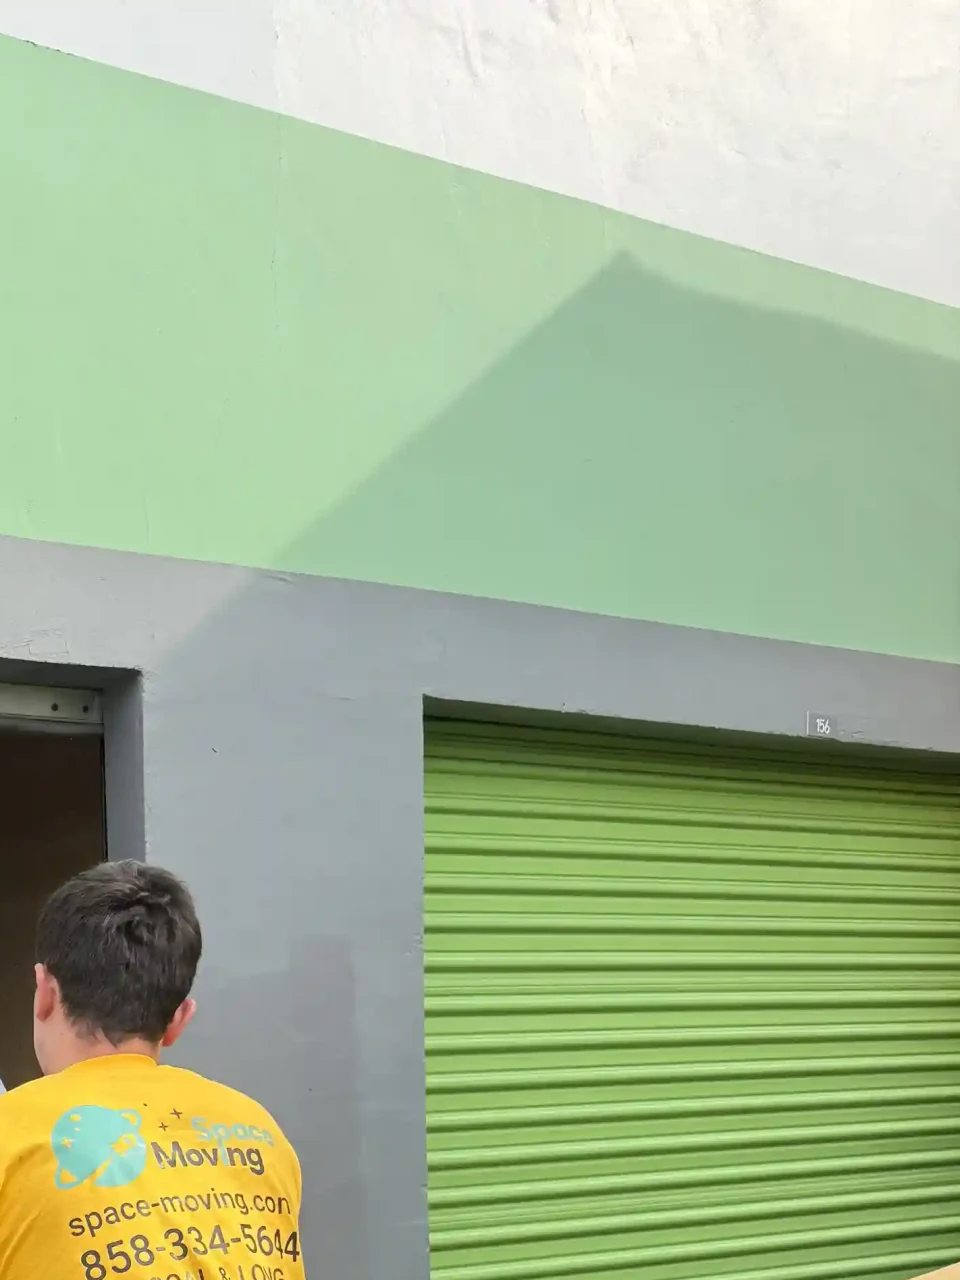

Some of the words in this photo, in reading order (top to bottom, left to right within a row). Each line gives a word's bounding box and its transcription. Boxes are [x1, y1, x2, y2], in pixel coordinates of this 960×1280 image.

[816, 718, 830, 734] 156
[191, 1116, 274, 1147] Space
[150, 1141, 265, 1176] Moving
